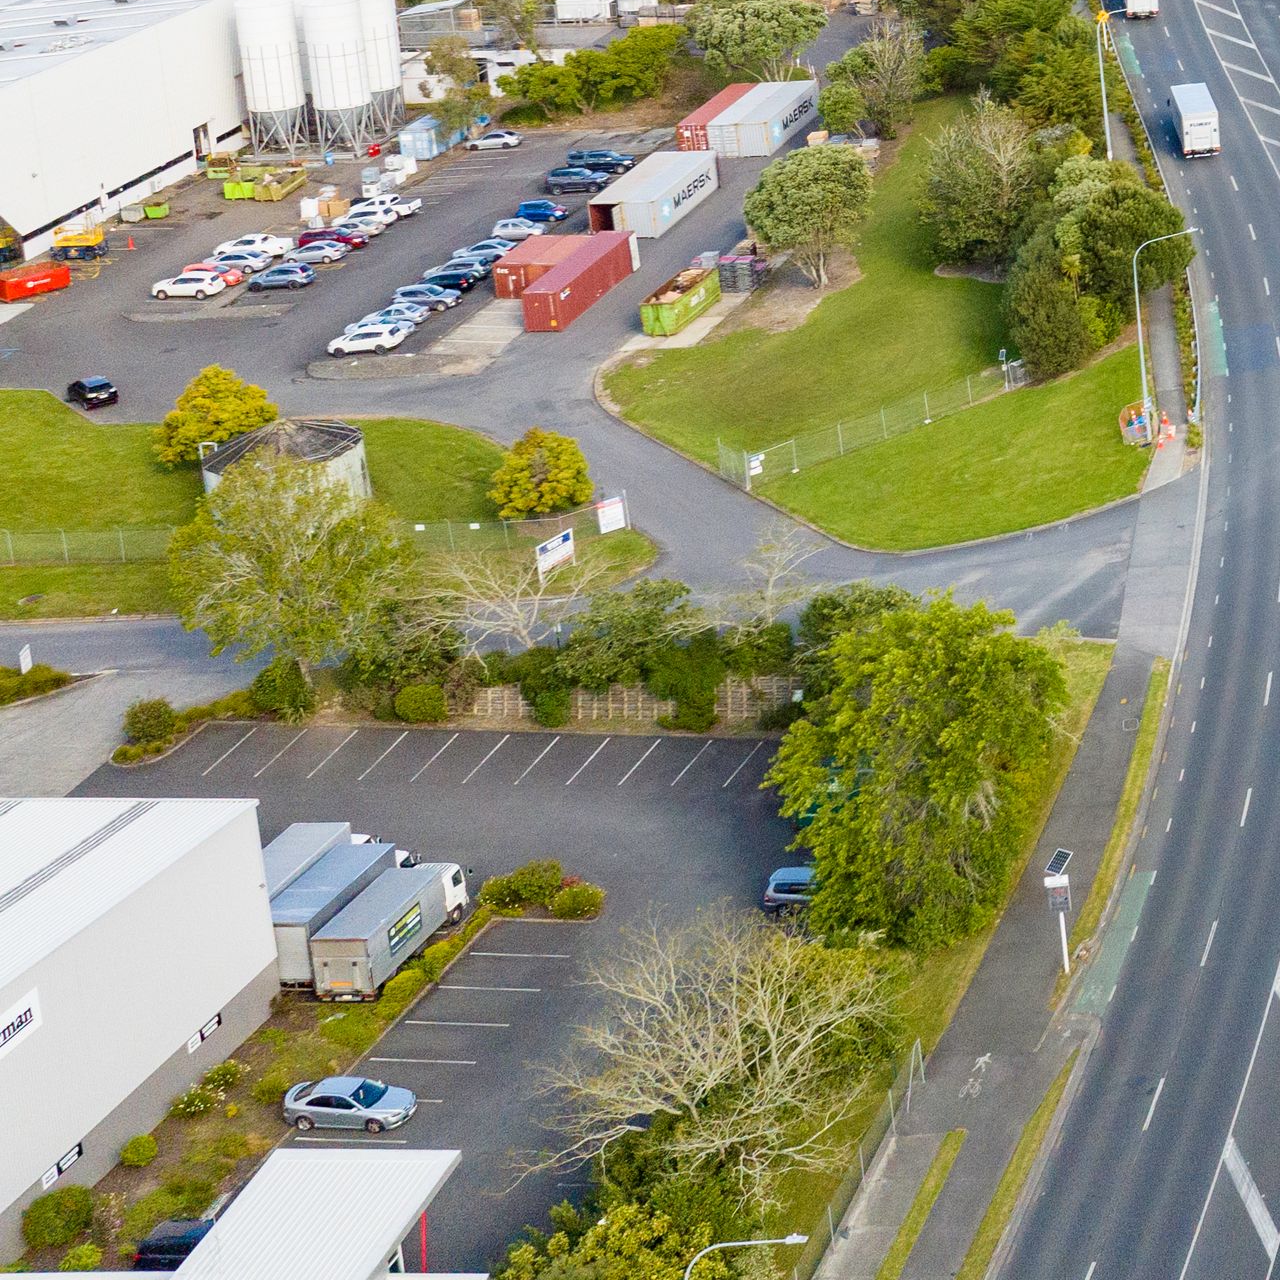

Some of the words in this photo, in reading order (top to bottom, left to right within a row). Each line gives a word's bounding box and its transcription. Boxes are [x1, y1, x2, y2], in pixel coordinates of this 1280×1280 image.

[782, 96, 814, 130] MAERSK
[673, 168, 712, 210] MAERSK
[0, 1008, 33, 1041] man
